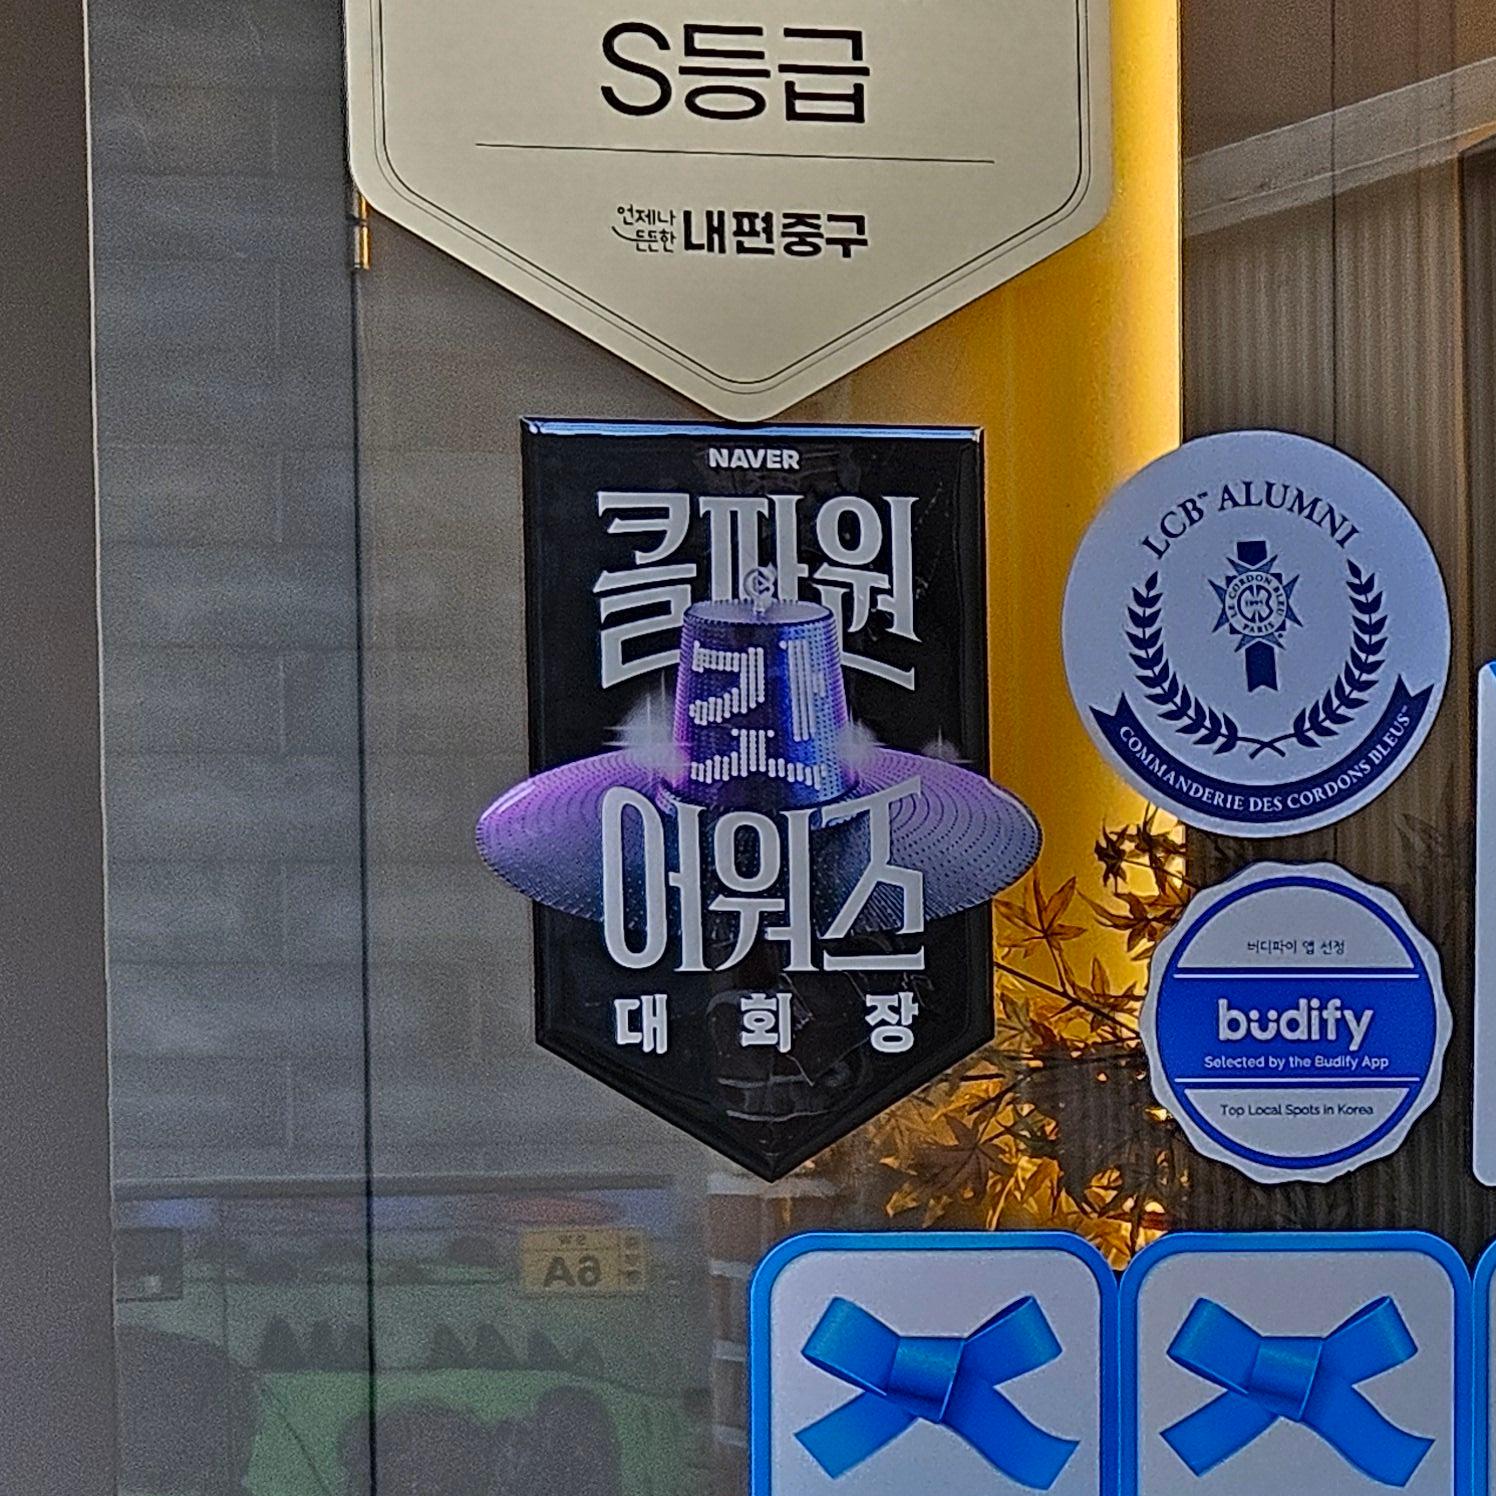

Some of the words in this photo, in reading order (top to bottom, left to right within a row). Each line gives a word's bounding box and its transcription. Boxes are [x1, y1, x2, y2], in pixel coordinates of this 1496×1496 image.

[600, 21, 870, 124] S등급
[617, 204, 677, 226] 언제나
[635, 229, 677, 254] 든든한
[682, 209, 869, 256] 내편중구
[709, 448, 799, 469] NAVER
[1218, 481, 1359, 549] ALUMNI
[1228, 573, 1273, 601] CORDON
[1241, 620, 1275, 634] PARIS
[1119, 726, 1245, 811] COMMANDERIE
[1248, 796, 1283, 812] DES
[1286, 759, 1372, 811] CORDONS
[602, 775, 926, 973] 어워즈
[1320, 938, 1345, 955] 선정
[1204, 1056, 1265, 1069] Selected
[1268, 1056, 1284, 1071] by
[1289, 1056, 1311, 1068] the
[1315, 1056, 1360, 1071] Budify
[1362, 1056, 1390, 1071] App
[1220, 1104, 1245, 1117] Top
[1248, 1104, 1282, 1116] Local
[1284, 1104, 1321, 1118] Spots
[1337, 1104, 1374, 1116] Korea
